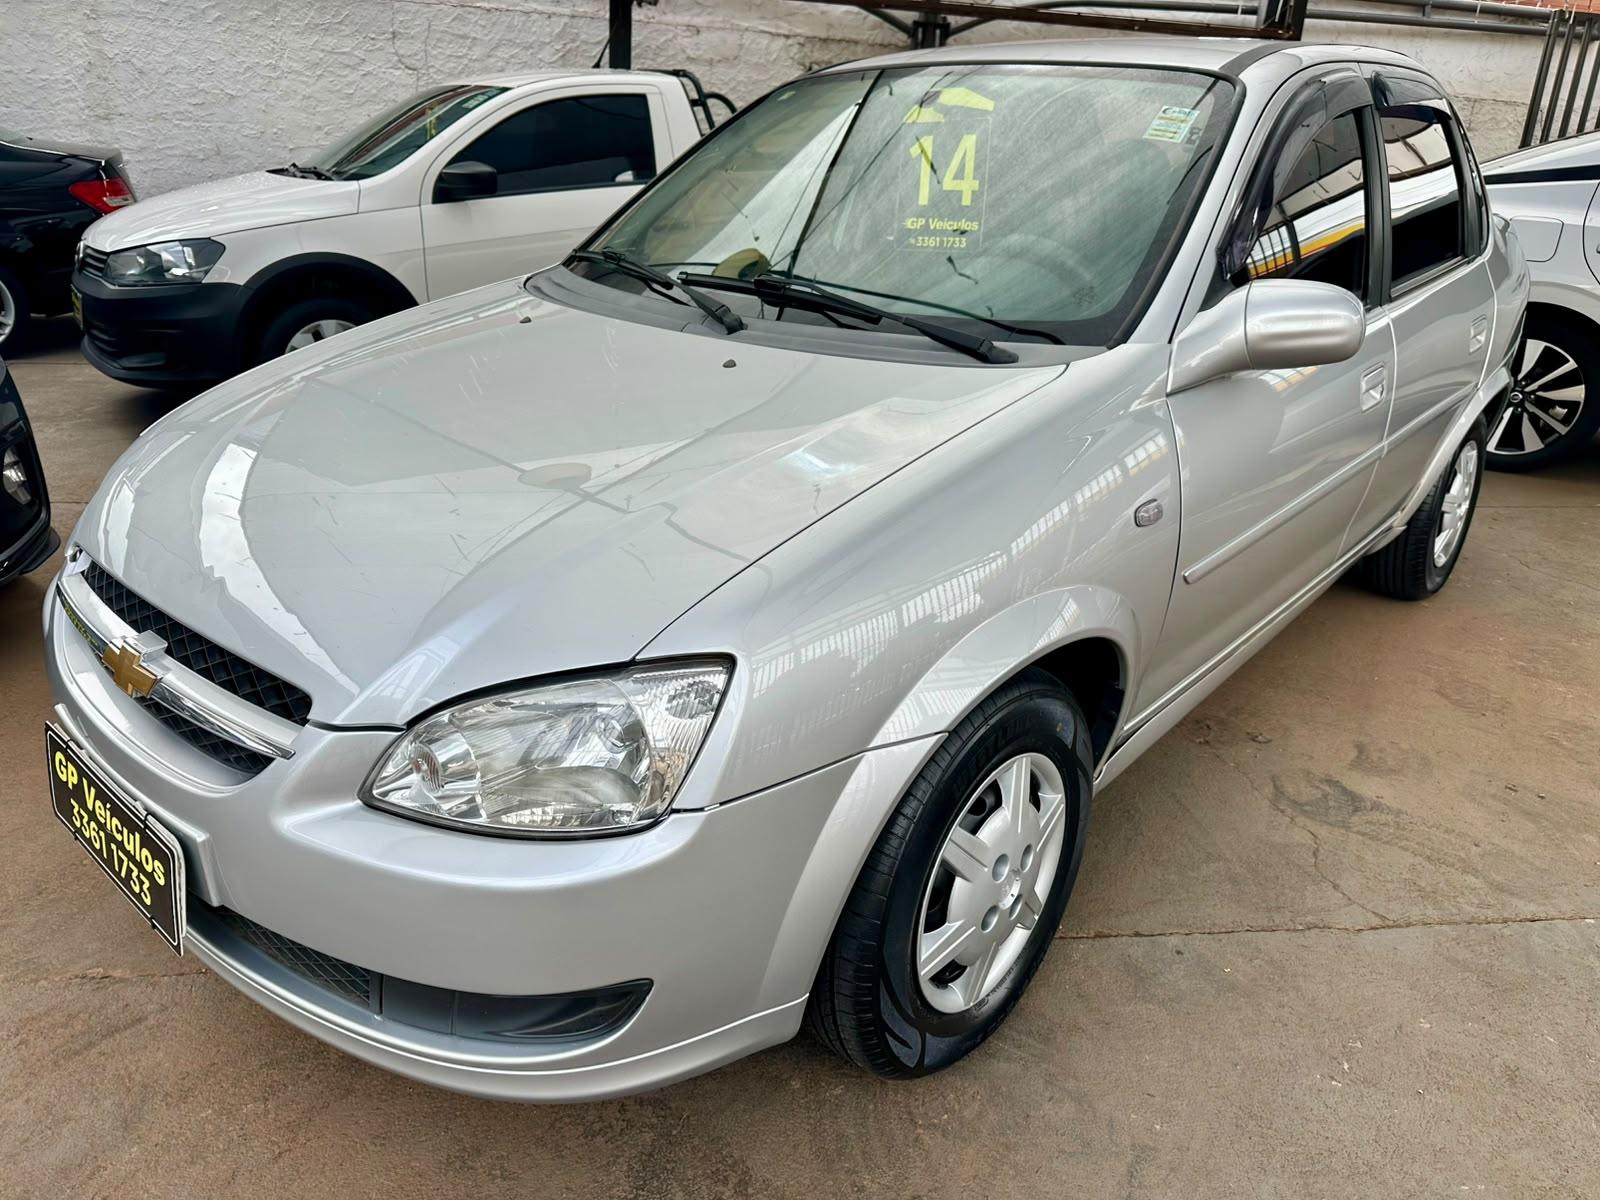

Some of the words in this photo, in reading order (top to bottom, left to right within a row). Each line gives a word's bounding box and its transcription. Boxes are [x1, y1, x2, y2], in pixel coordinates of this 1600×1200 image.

[909, 133, 980, 207] 14
[904, 217, 926, 231] GP
[915, 236, 940, 248] 3361
[942, 237, 967, 249] 1733
[54, 750, 78, 791] GP
[70, 798, 107, 860] 3361
[110, 841, 152, 906] 1733
